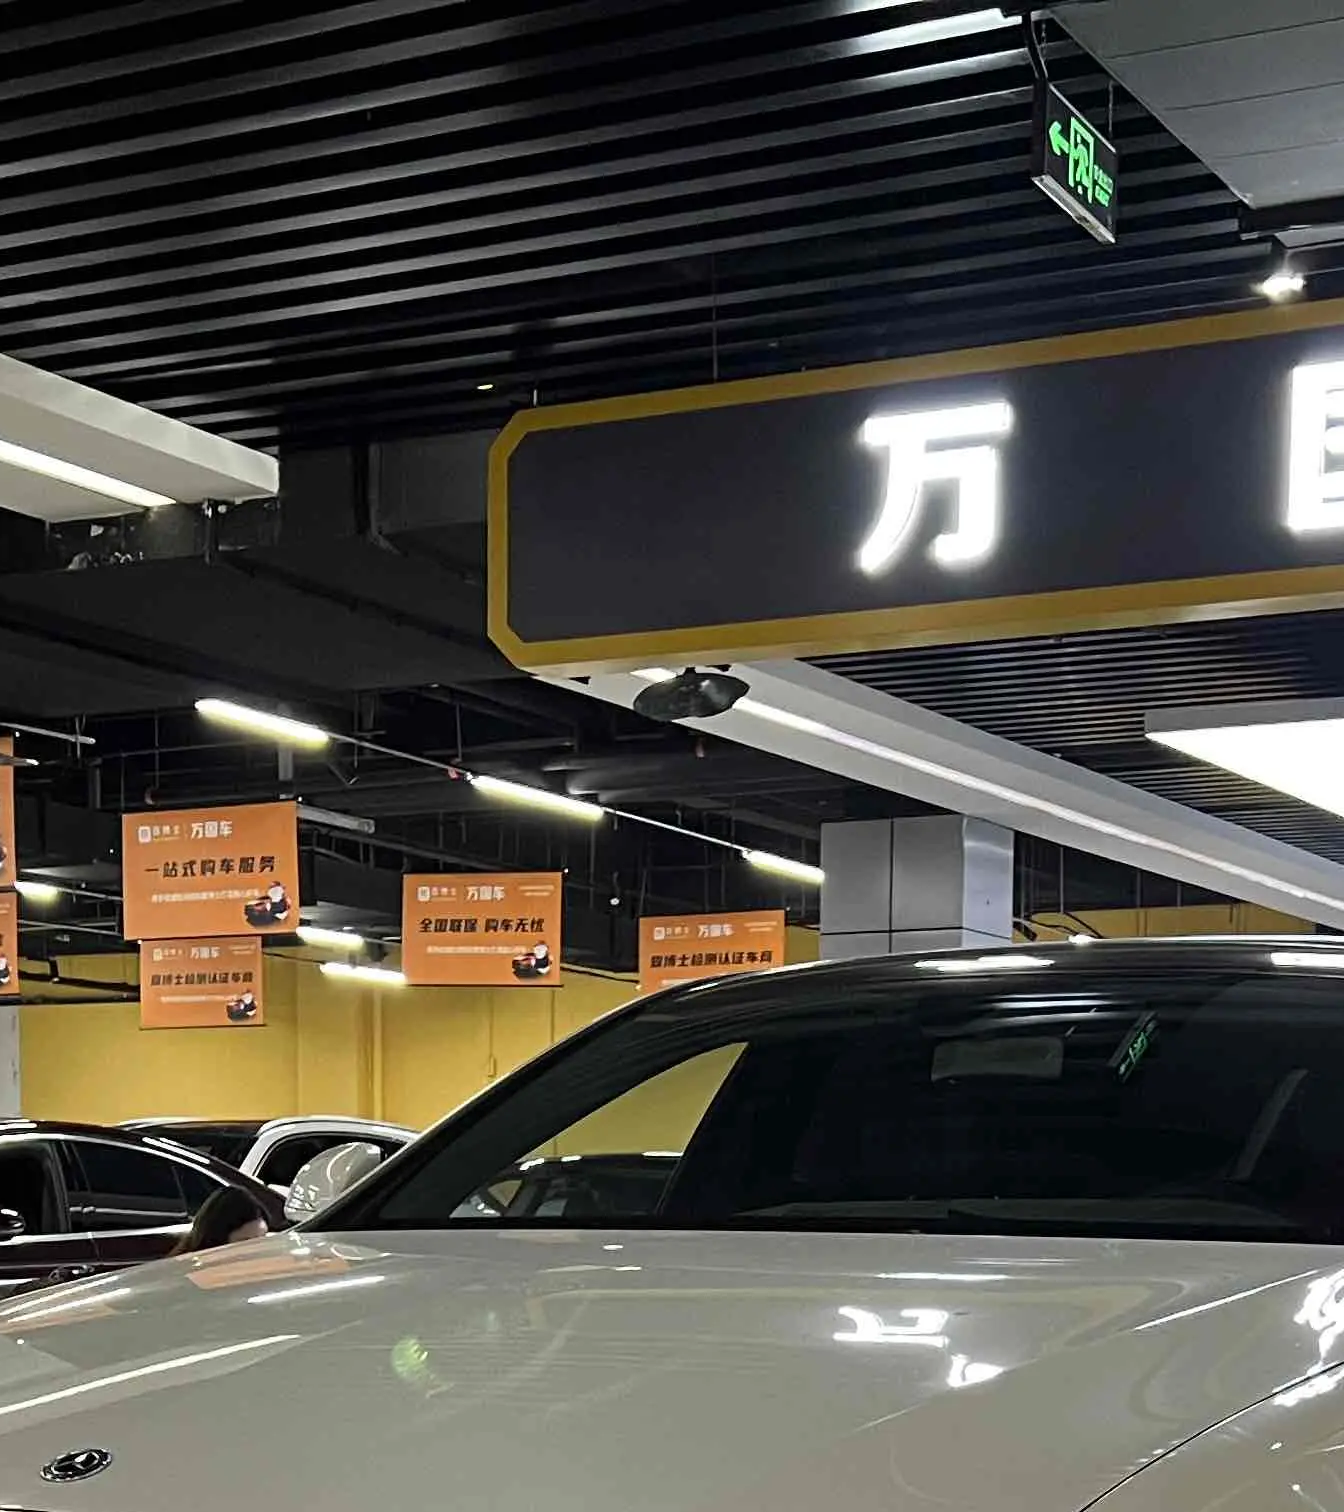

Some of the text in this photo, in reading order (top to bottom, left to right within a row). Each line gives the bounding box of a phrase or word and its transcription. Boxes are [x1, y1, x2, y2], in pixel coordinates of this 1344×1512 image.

[190, 820, 233, 839] 万国车
[144, 855, 276, 878] 一站式购车服务
[466, 885, 505, 901] 万国车
[484, 917, 545, 933] 购车无忧
